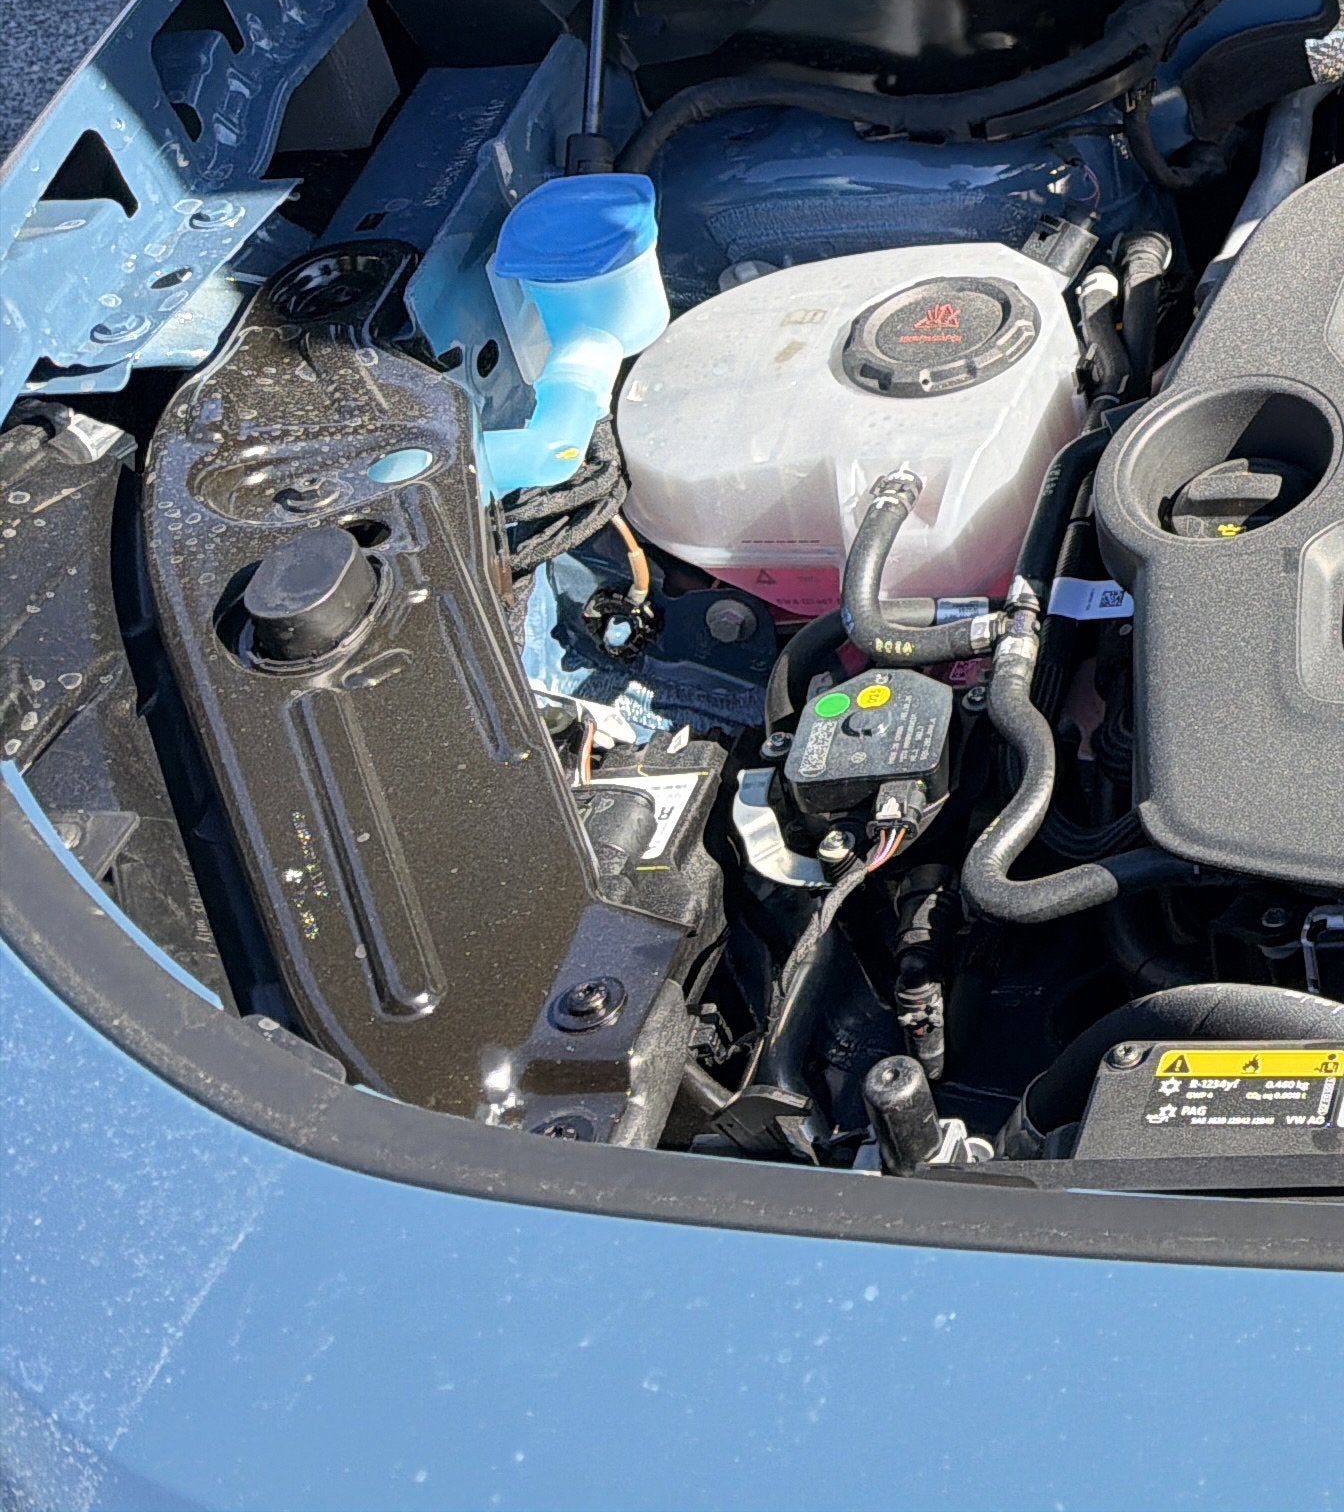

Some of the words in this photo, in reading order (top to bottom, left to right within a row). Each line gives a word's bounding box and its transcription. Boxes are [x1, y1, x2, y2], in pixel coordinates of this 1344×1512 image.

[1190, 1078, 1241, 1091] R-1234yf
[1296, 1079, 1310, 1091] kg
[1181, 1106, 1208, 1116] PAG
[1286, 1116, 1307, 1124] VW
[1307, 1116, 1326, 1124] AG
